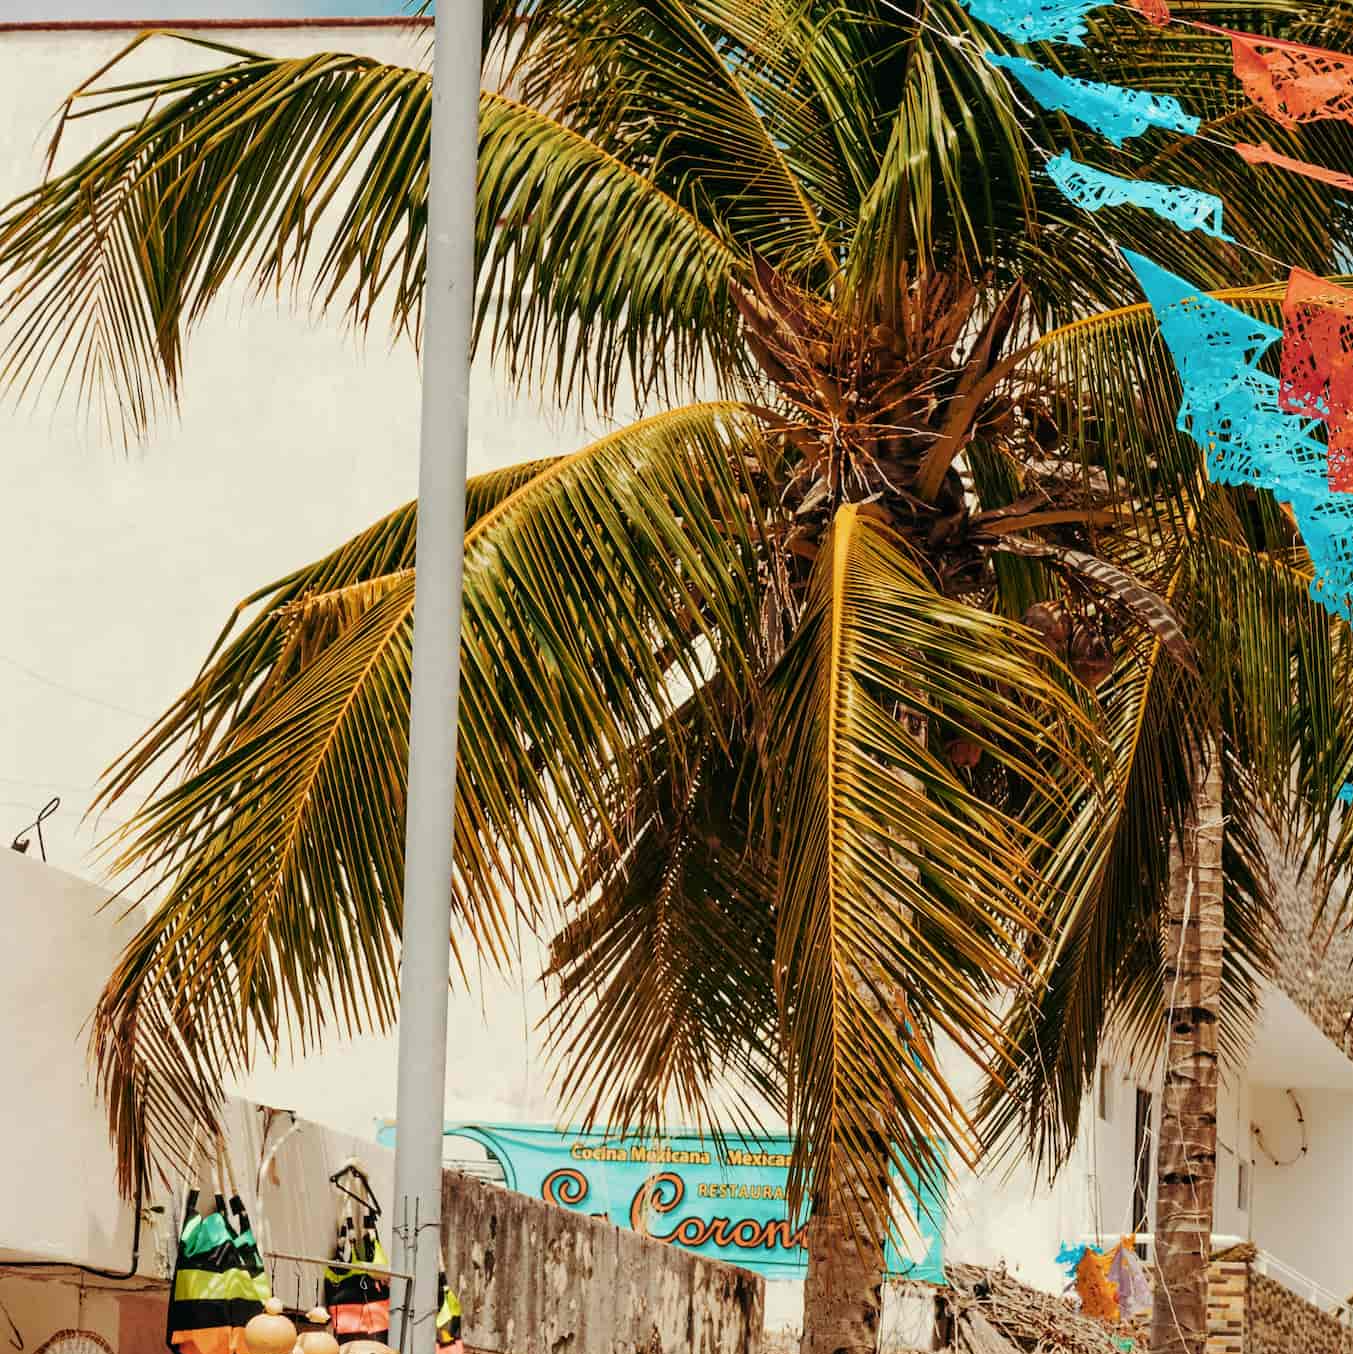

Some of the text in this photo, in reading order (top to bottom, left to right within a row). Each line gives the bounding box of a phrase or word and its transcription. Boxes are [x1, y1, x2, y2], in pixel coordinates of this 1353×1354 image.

[571, 1143, 628, 1162] Cocina
[631, 1145, 712, 1165] Mexicana
[697, 1183, 786, 1201] RESTAURA
